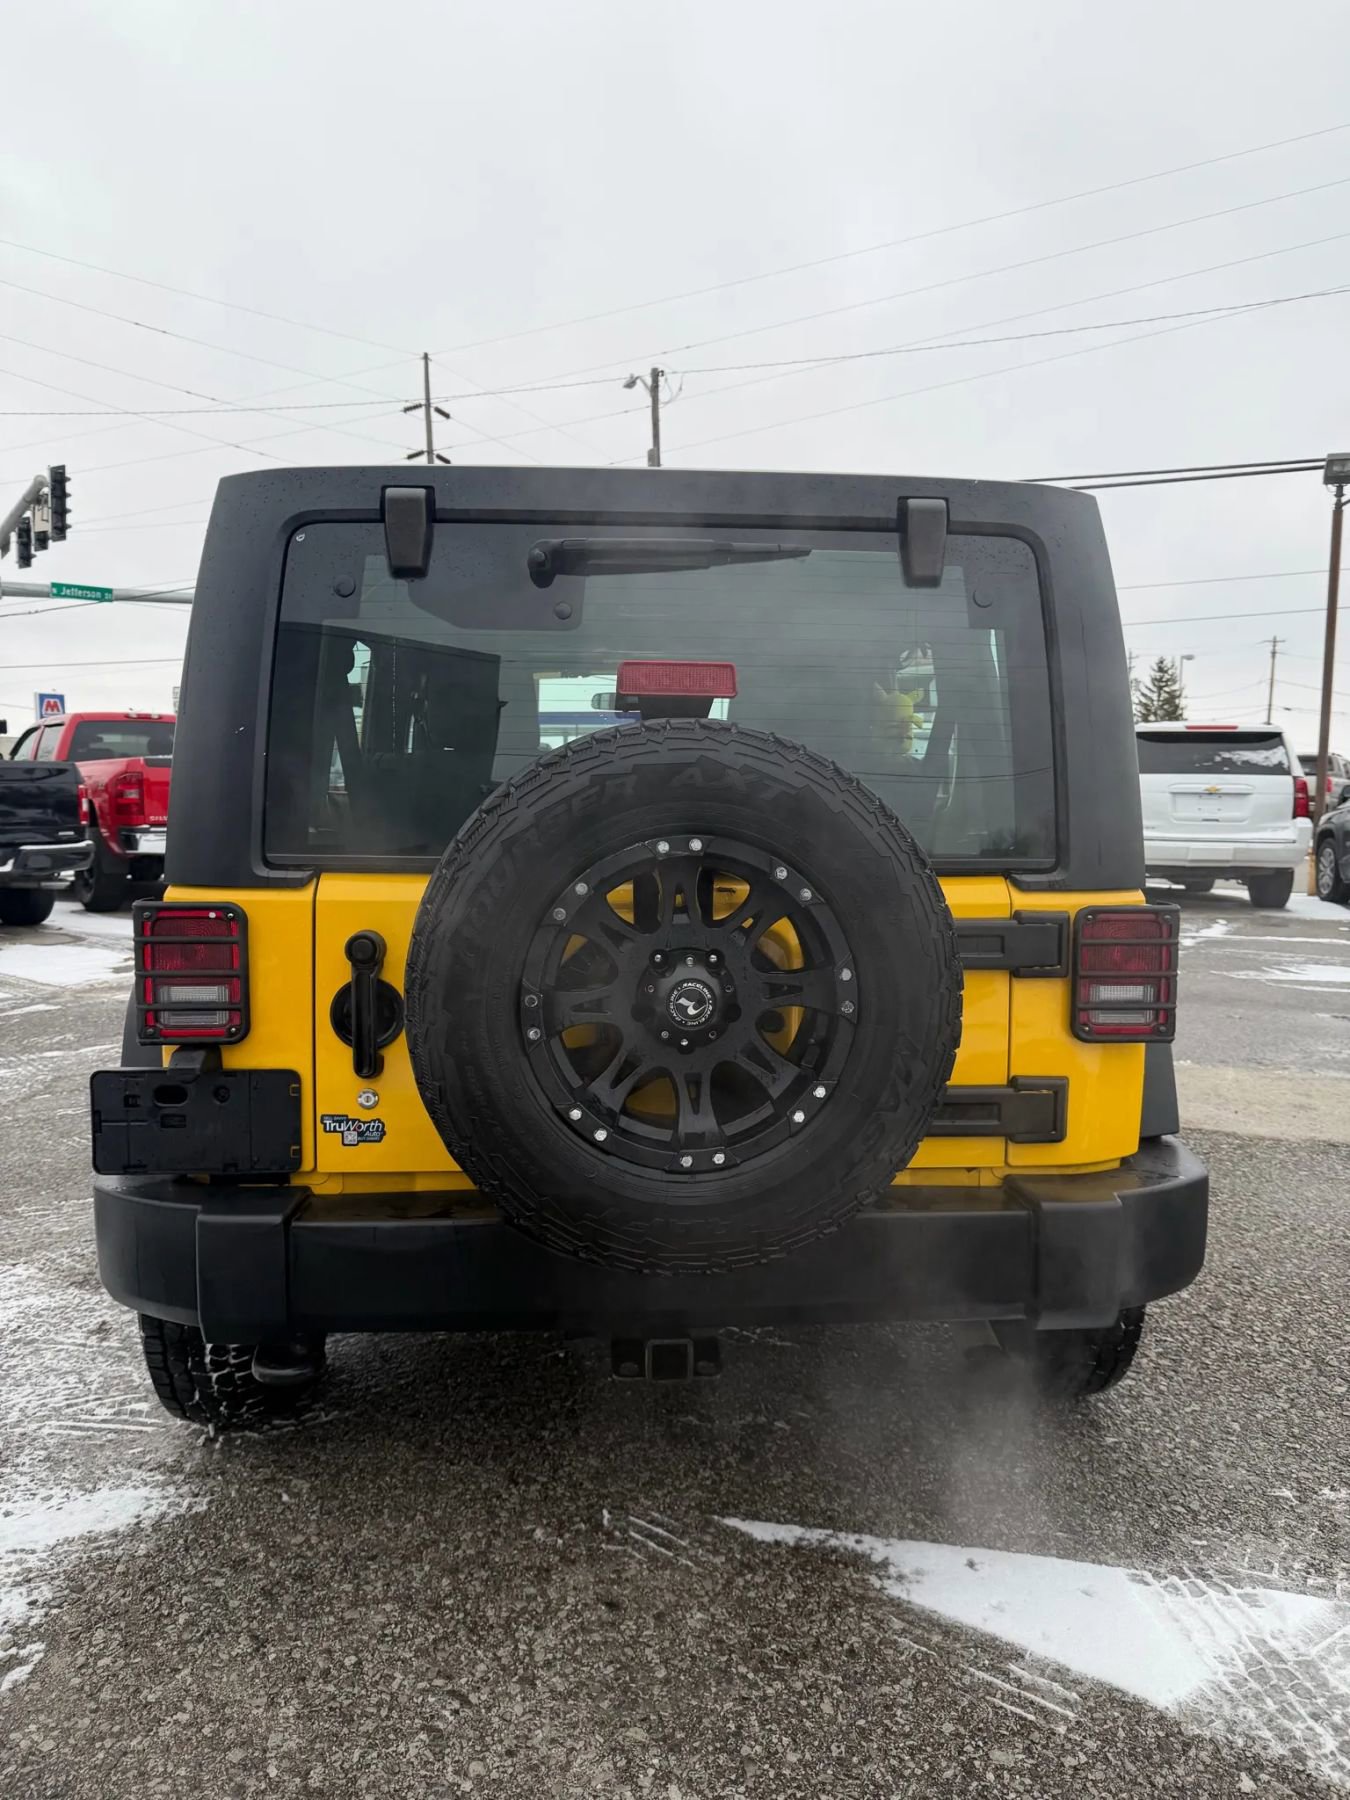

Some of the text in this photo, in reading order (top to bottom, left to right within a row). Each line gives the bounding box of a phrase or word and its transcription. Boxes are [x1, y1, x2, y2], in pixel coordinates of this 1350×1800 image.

[61, 586, 101, 599] Jefferson
[682, 982, 711, 998] RACELINE
[323, 1120, 382, 1131] TruWorth
